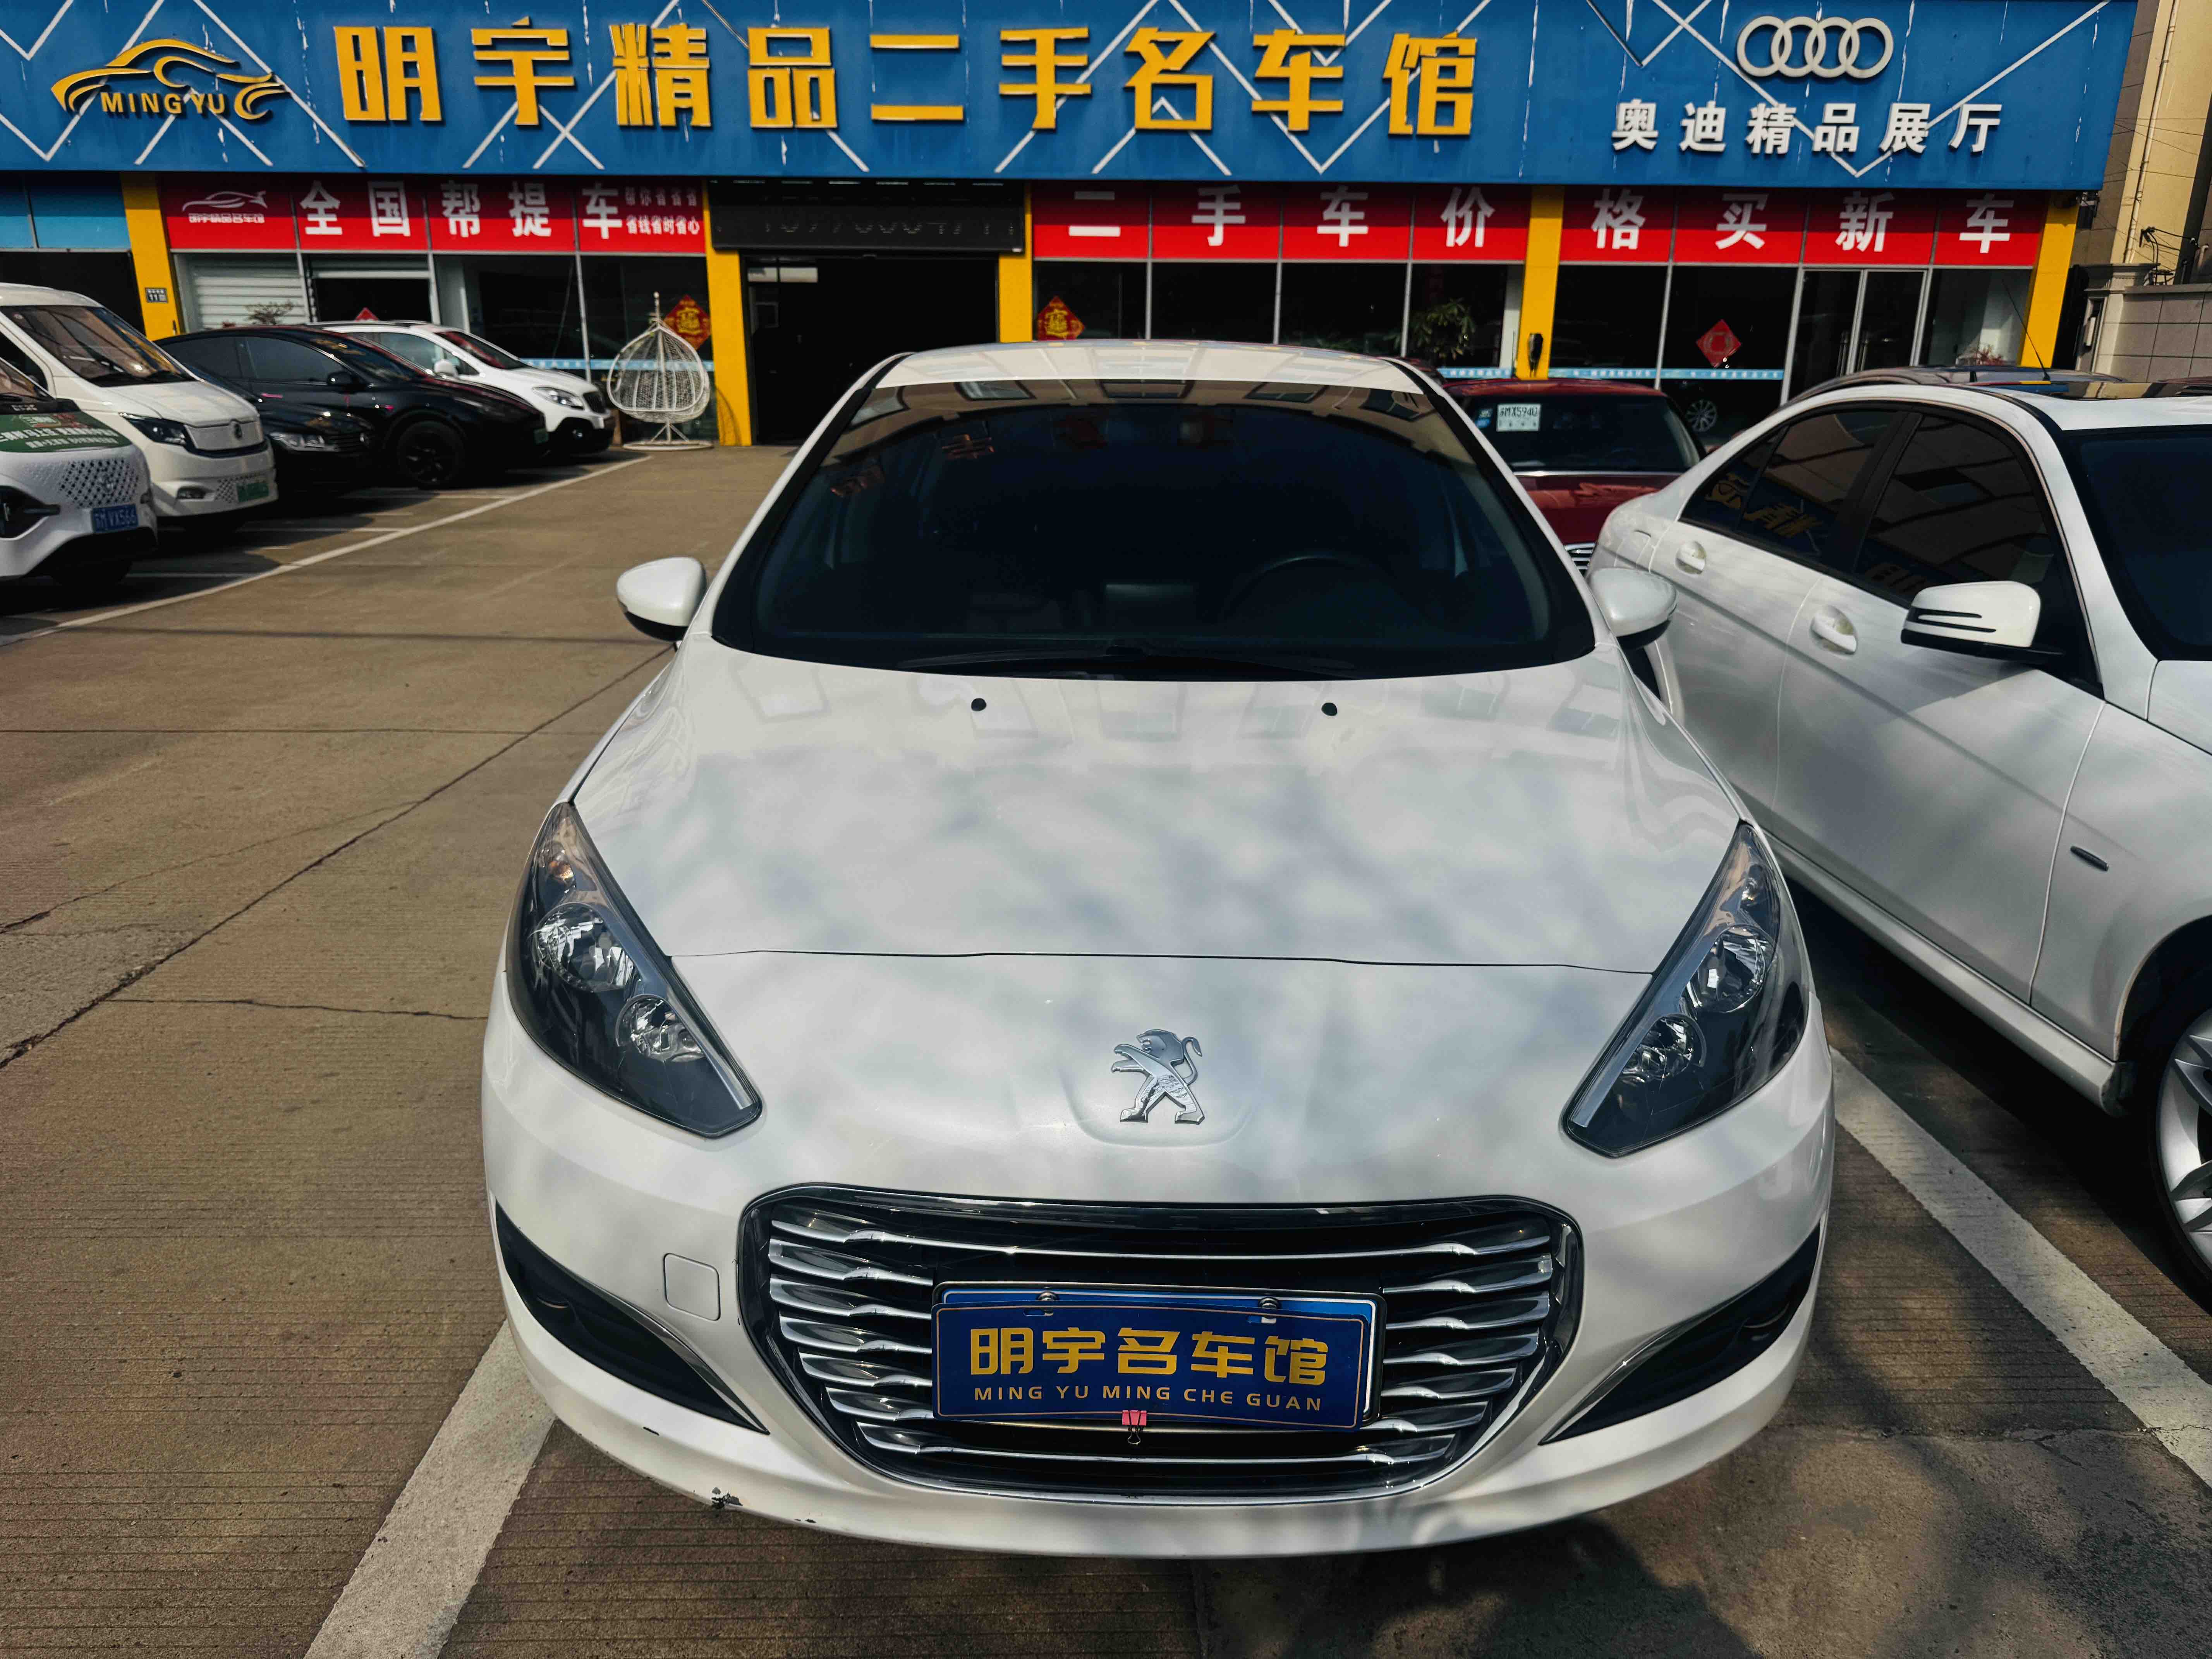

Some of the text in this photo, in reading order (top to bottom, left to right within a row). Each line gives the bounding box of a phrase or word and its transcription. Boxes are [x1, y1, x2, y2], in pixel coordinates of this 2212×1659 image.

[334, 16, 1477, 135] 明宇精品二手名车馆
[1611, 99, 2002, 154] 奥迪精品展厅
[299, 180, 623, 240] 全国帮提车
[970, 1327, 1328, 1386] 明宇名车馆
[975, 1385, 1321, 1411] MING YU MING CHE GUAN
